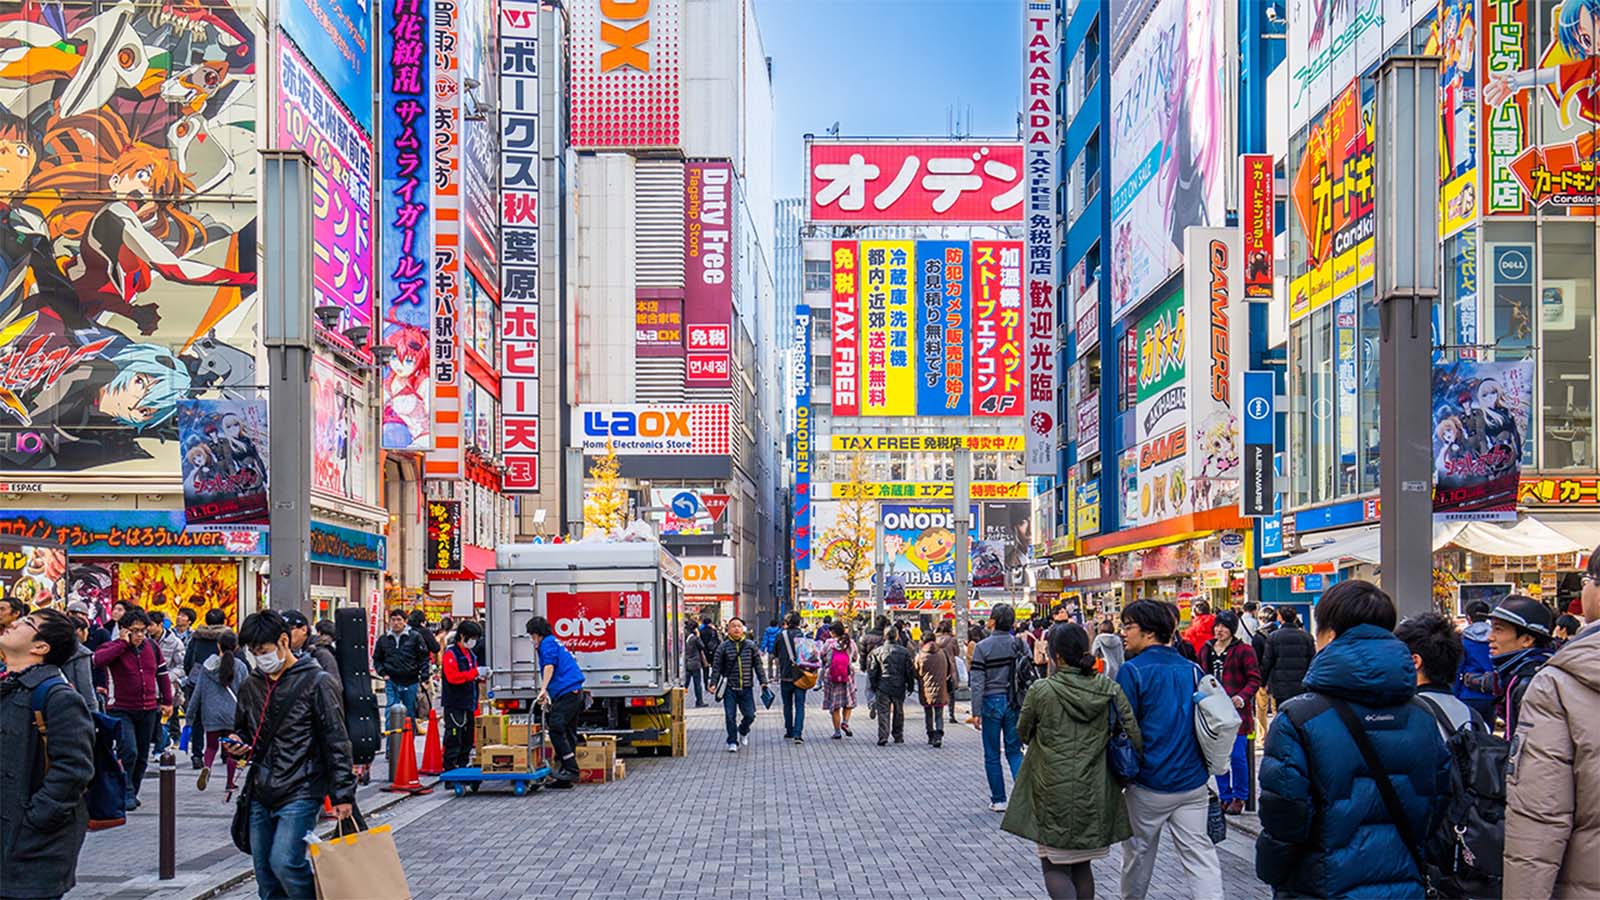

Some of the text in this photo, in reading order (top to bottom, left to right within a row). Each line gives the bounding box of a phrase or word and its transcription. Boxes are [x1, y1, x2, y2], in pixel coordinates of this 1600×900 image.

[1029, 18, 1050, 144] TAKARADA
[1490, 0, 1521, 208] ードゲム専門店
[282, 52, 371, 184] 赤坂見附駅前店
[390, 101, 425, 305] サムライガールズ
[688, 168, 700, 257] Flagship Store
[814, 147, 1024, 213] オノデン
[701, 169, 729, 285] Duty Free
[1030, 214, 1051, 275] 免税商店
[1502, 261, 1525, 270] DELL
[435, 251, 453, 382] アキバ駅前店
[690, 329, 726, 346] 免税
[834, 247, 855, 406] 免税 TAX FREE
[924, 260, 942, 388] お見積り無料です
[1210, 240, 1230, 409] GAMERS
[690, 361, 726, 374] 면세점
[795, 314, 810, 396] Panasonic
[981, 396, 1015, 413] 4F
[613, 439, 664, 449] Electronics
[666, 440, 692, 449] Store
[796, 406, 809, 473] ONODEN
[839, 437, 873, 449] TAX
[877, 437, 921, 449] FREE
[924, 437, 962, 449] 免税店
[12, 483, 43, 492] ESPACE
[1560, 480, 1600, 502] カー
[683, 564, 717, 581] OX
